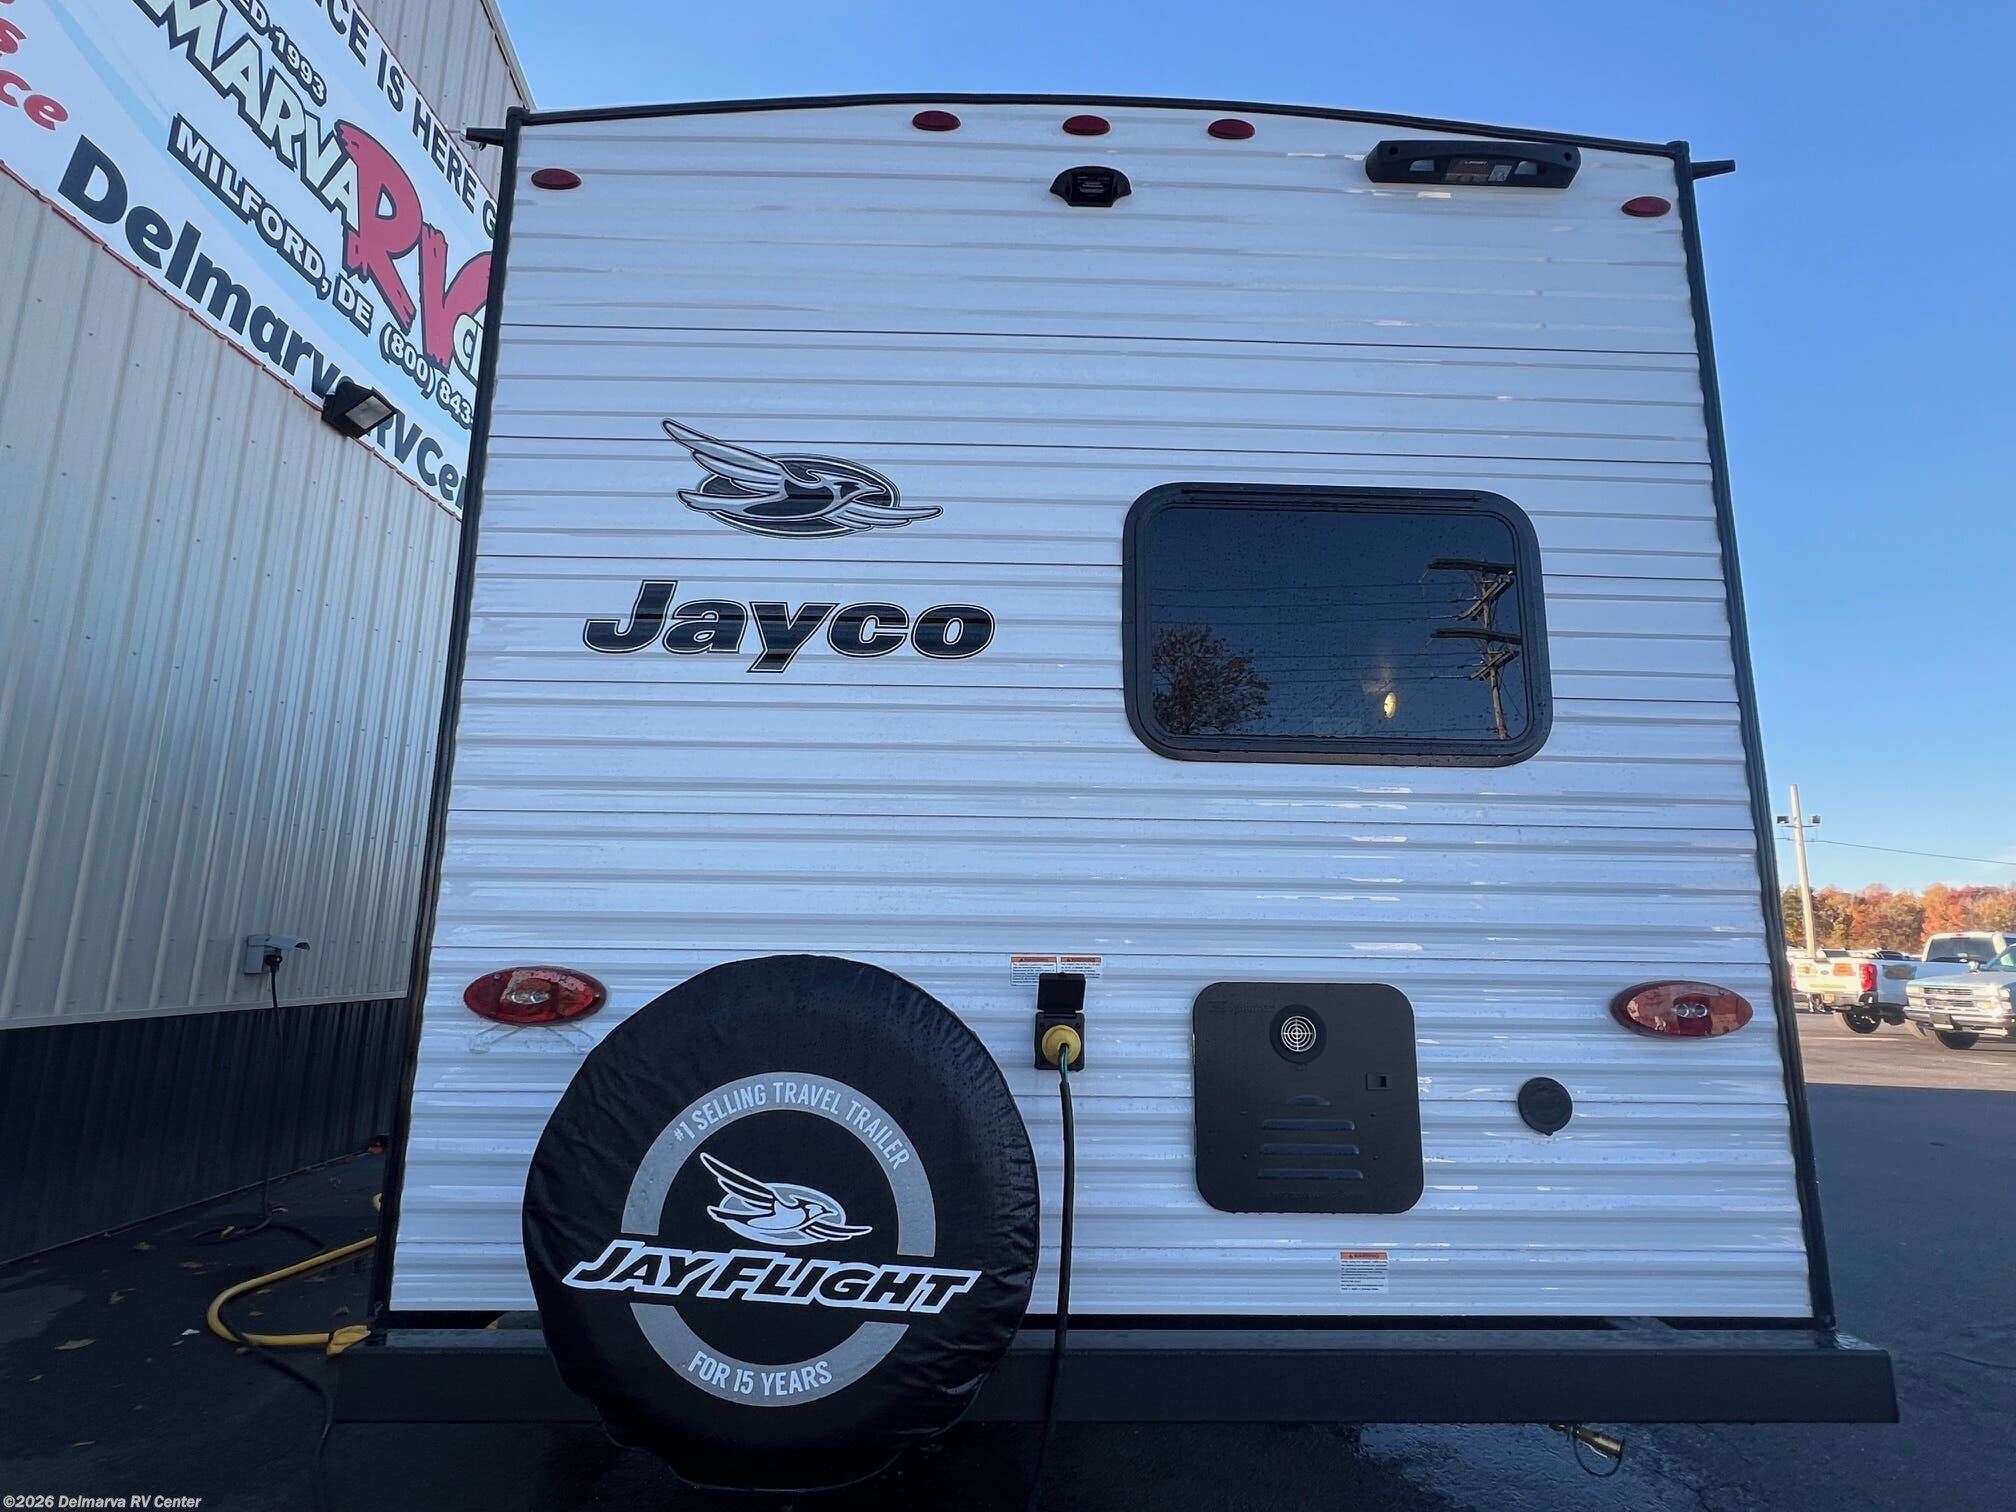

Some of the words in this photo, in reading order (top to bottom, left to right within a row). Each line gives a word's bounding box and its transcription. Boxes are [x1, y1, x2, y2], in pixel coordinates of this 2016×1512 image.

[269, 25, 327, 107] 1993
[313, 0, 372, 68] CE
[377, 47, 405, 113] IS
[412, 96, 478, 215] HERE
[167, 112, 332, 300] MILFORD,
[332, 273, 374, 338] DE
[379, 321, 436, 400] (800)
[583, 579, 996, 674] Jayco
[673, 1121, 696, 1142] #1
[691, 1084, 767, 1131] SELLING
[772, 1082, 842, 1115] TRAVEL
[845, 1100, 910, 1170] TRAILER
[687, 1350, 731, 1389] FOR
[733, 1368, 755, 1395] 15
[760, 1360, 833, 1396] YEARS
